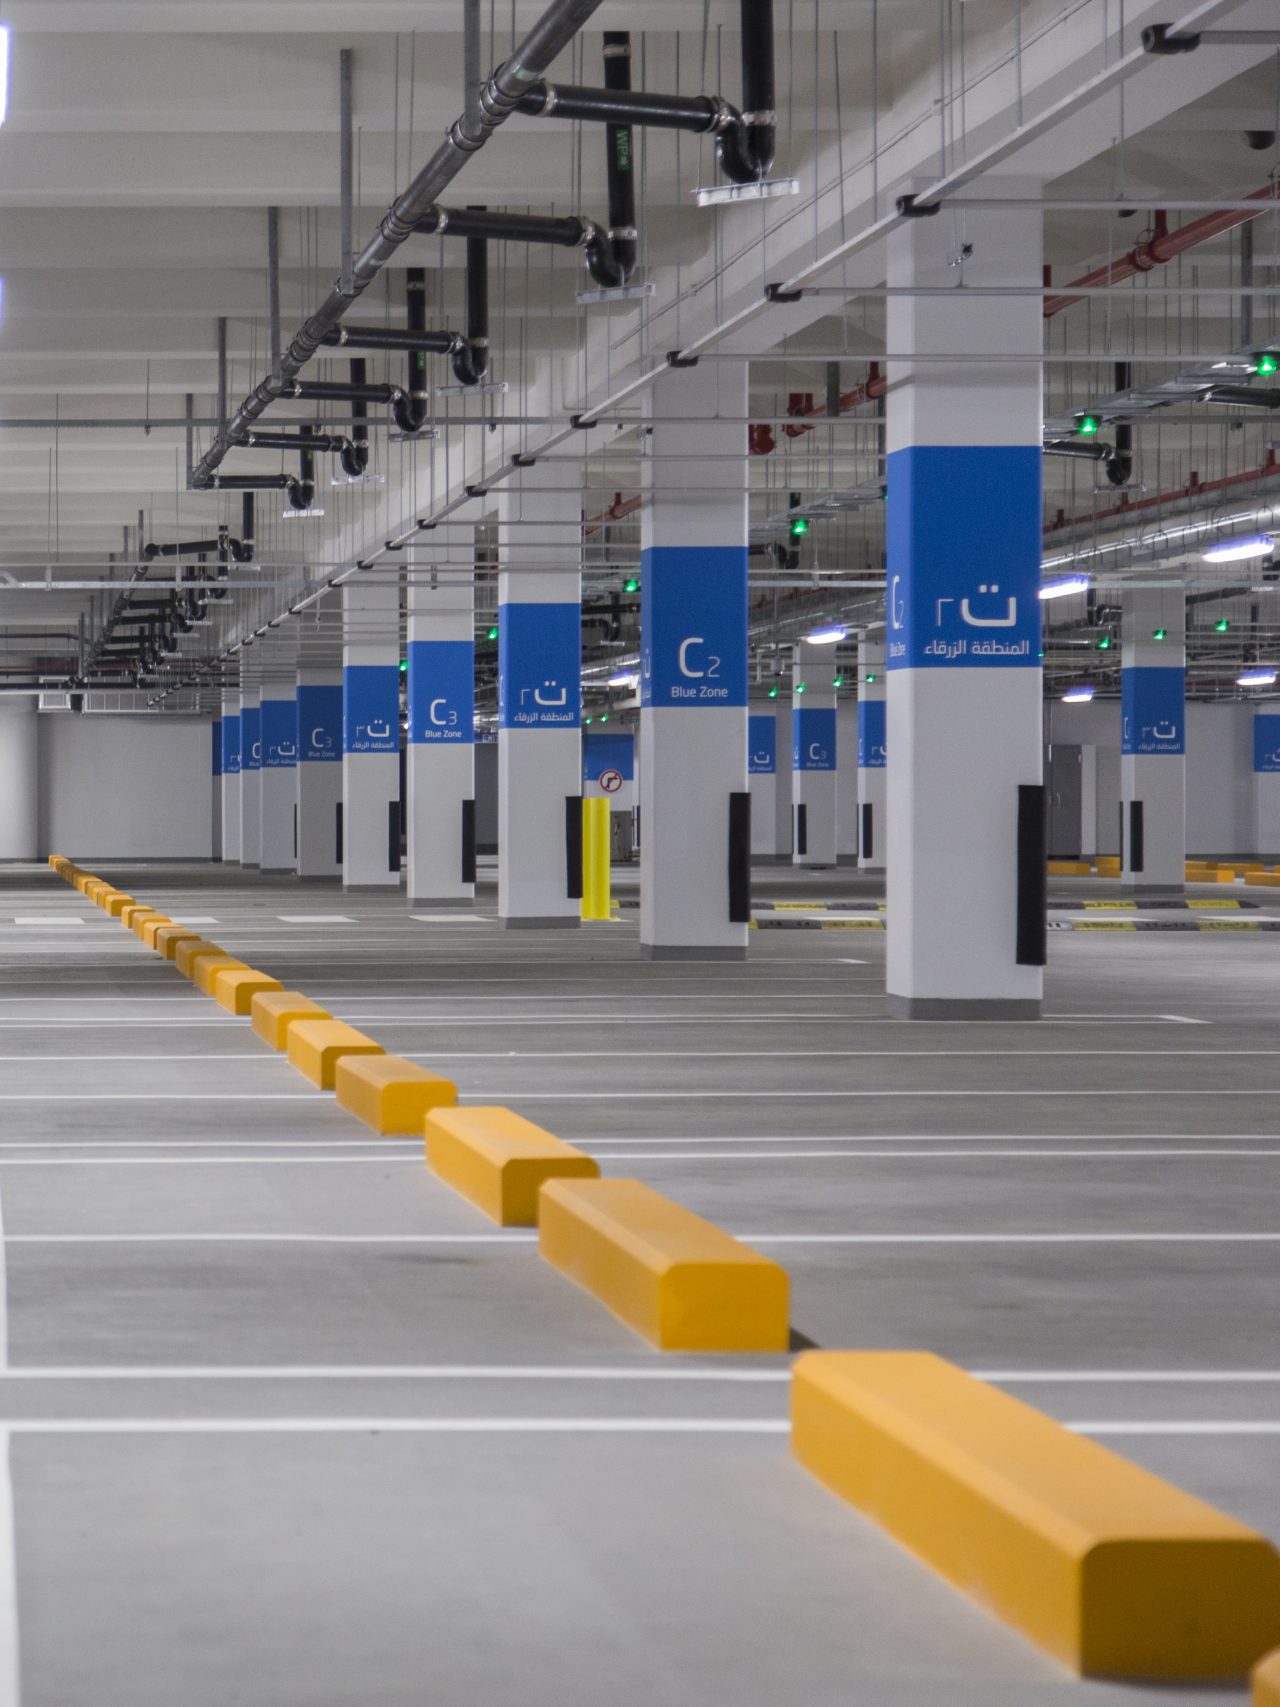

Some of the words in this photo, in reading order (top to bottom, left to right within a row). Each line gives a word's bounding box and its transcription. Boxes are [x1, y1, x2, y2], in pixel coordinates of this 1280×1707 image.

[924, 639, 967, 659] الزرقاء
[972, 639, 1030, 655] المنطقة
[671, 686, 697, 698] Blue
[699, 686, 728, 698] Zone
[514, 712, 538, 723] الزرقاء
[540, 712, 574, 721] المنطقة
[425, 730, 442, 738] Blue
[443, 730, 462, 738] Zone
